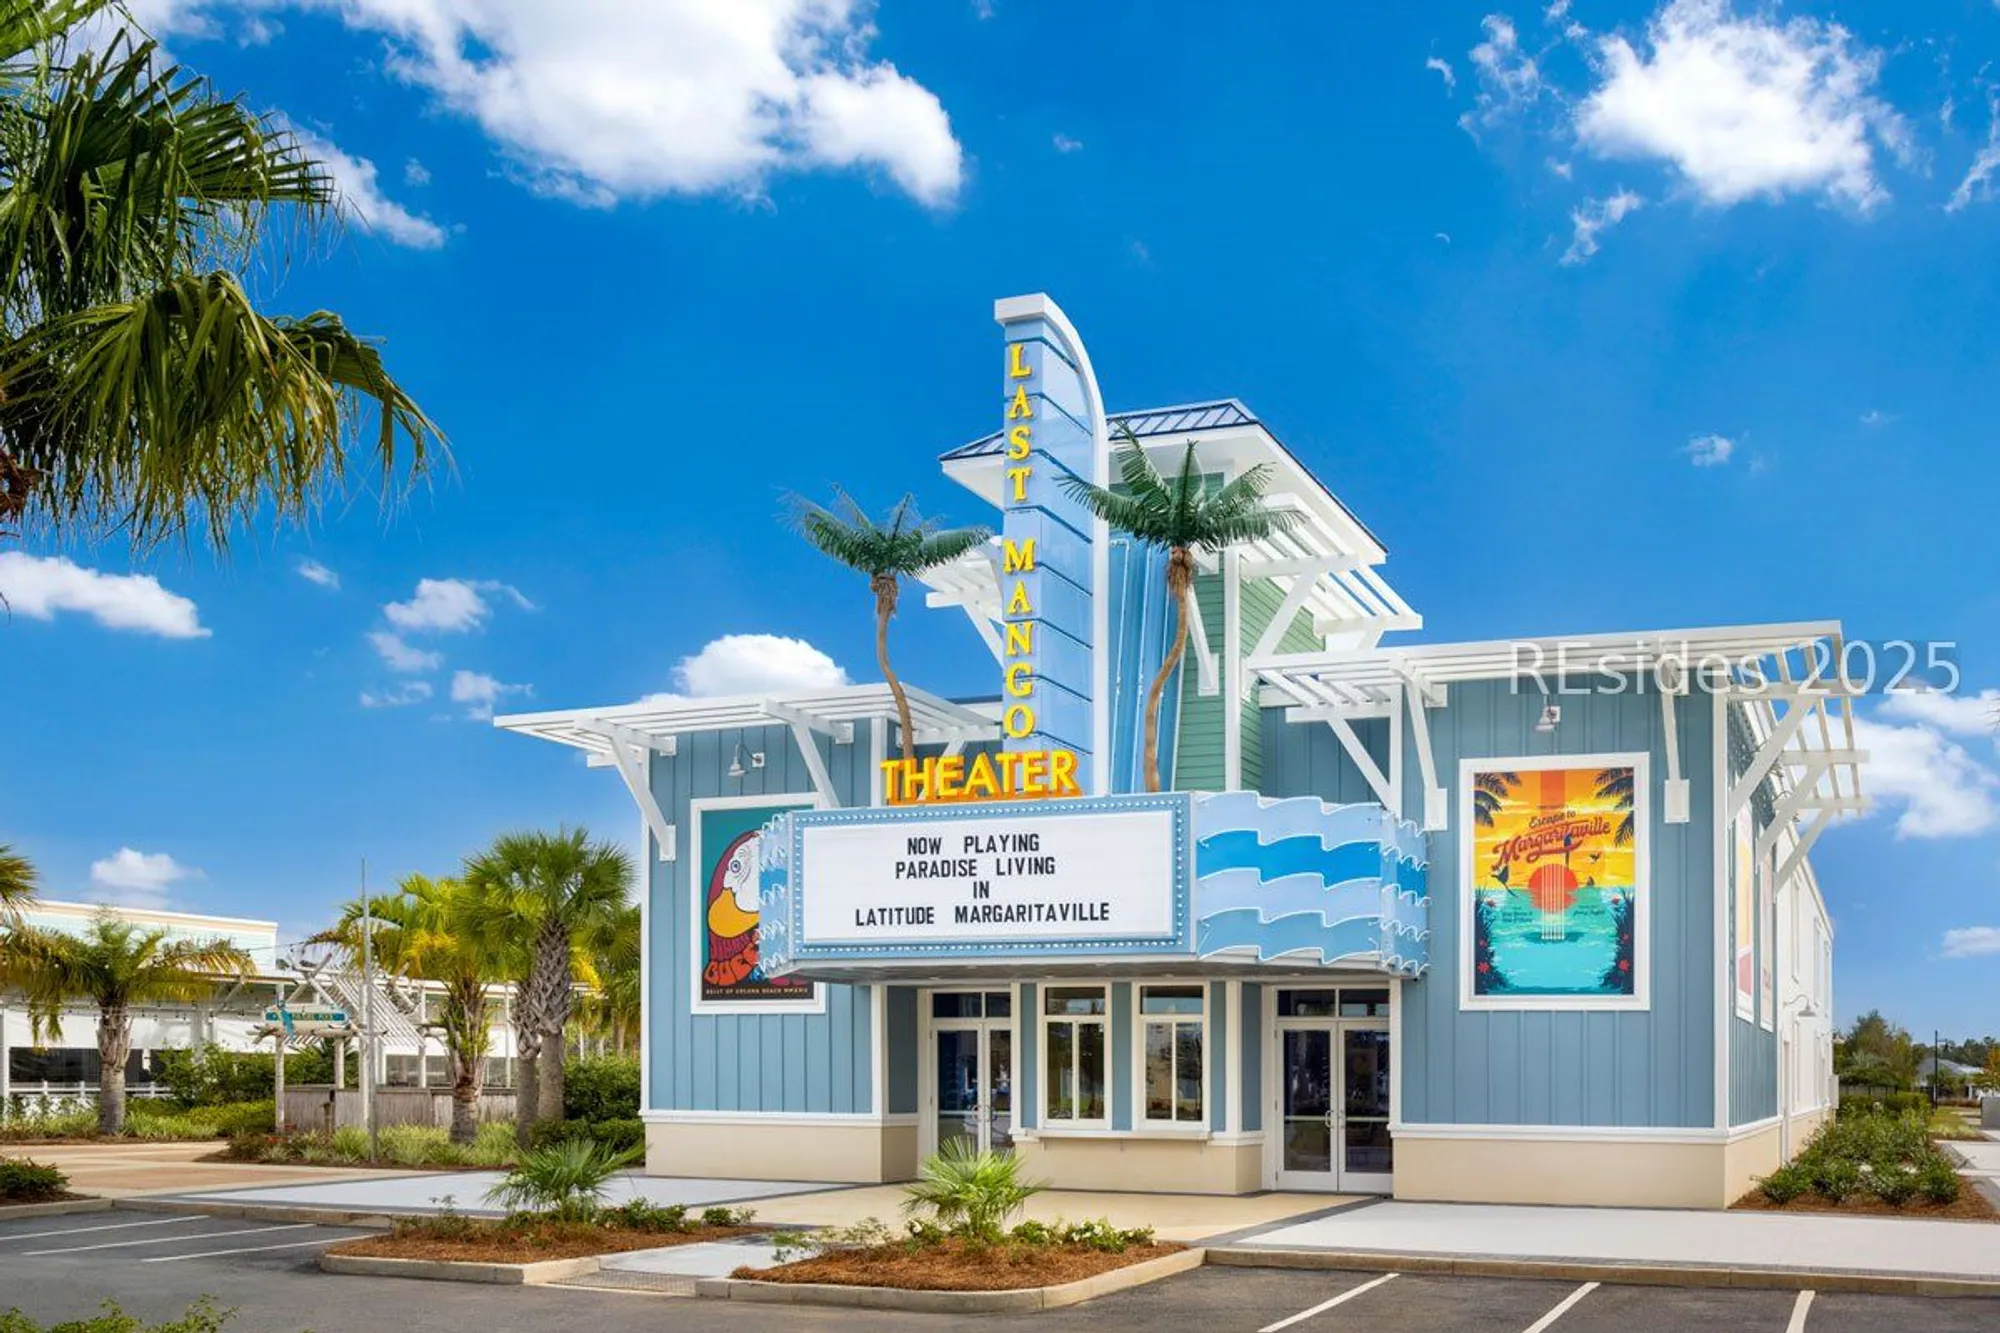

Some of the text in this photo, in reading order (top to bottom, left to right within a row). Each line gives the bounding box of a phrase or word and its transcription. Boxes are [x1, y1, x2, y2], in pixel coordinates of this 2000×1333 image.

[1003, 343, 1036, 739] LAST MANGO
[880, 750, 1081, 801] THEATER
[1528, 810, 1577, 829] Escape to
[908, 833, 1040, 855] NOW PLAYING
[1491, 816, 1612, 872] Margaritaville
[895, 857, 1055, 879] PARADISE LIVING
[973, 881, 990, 899] IN
[855, 902, 1109, 926] LATITUDE MARGARITAVILLE
